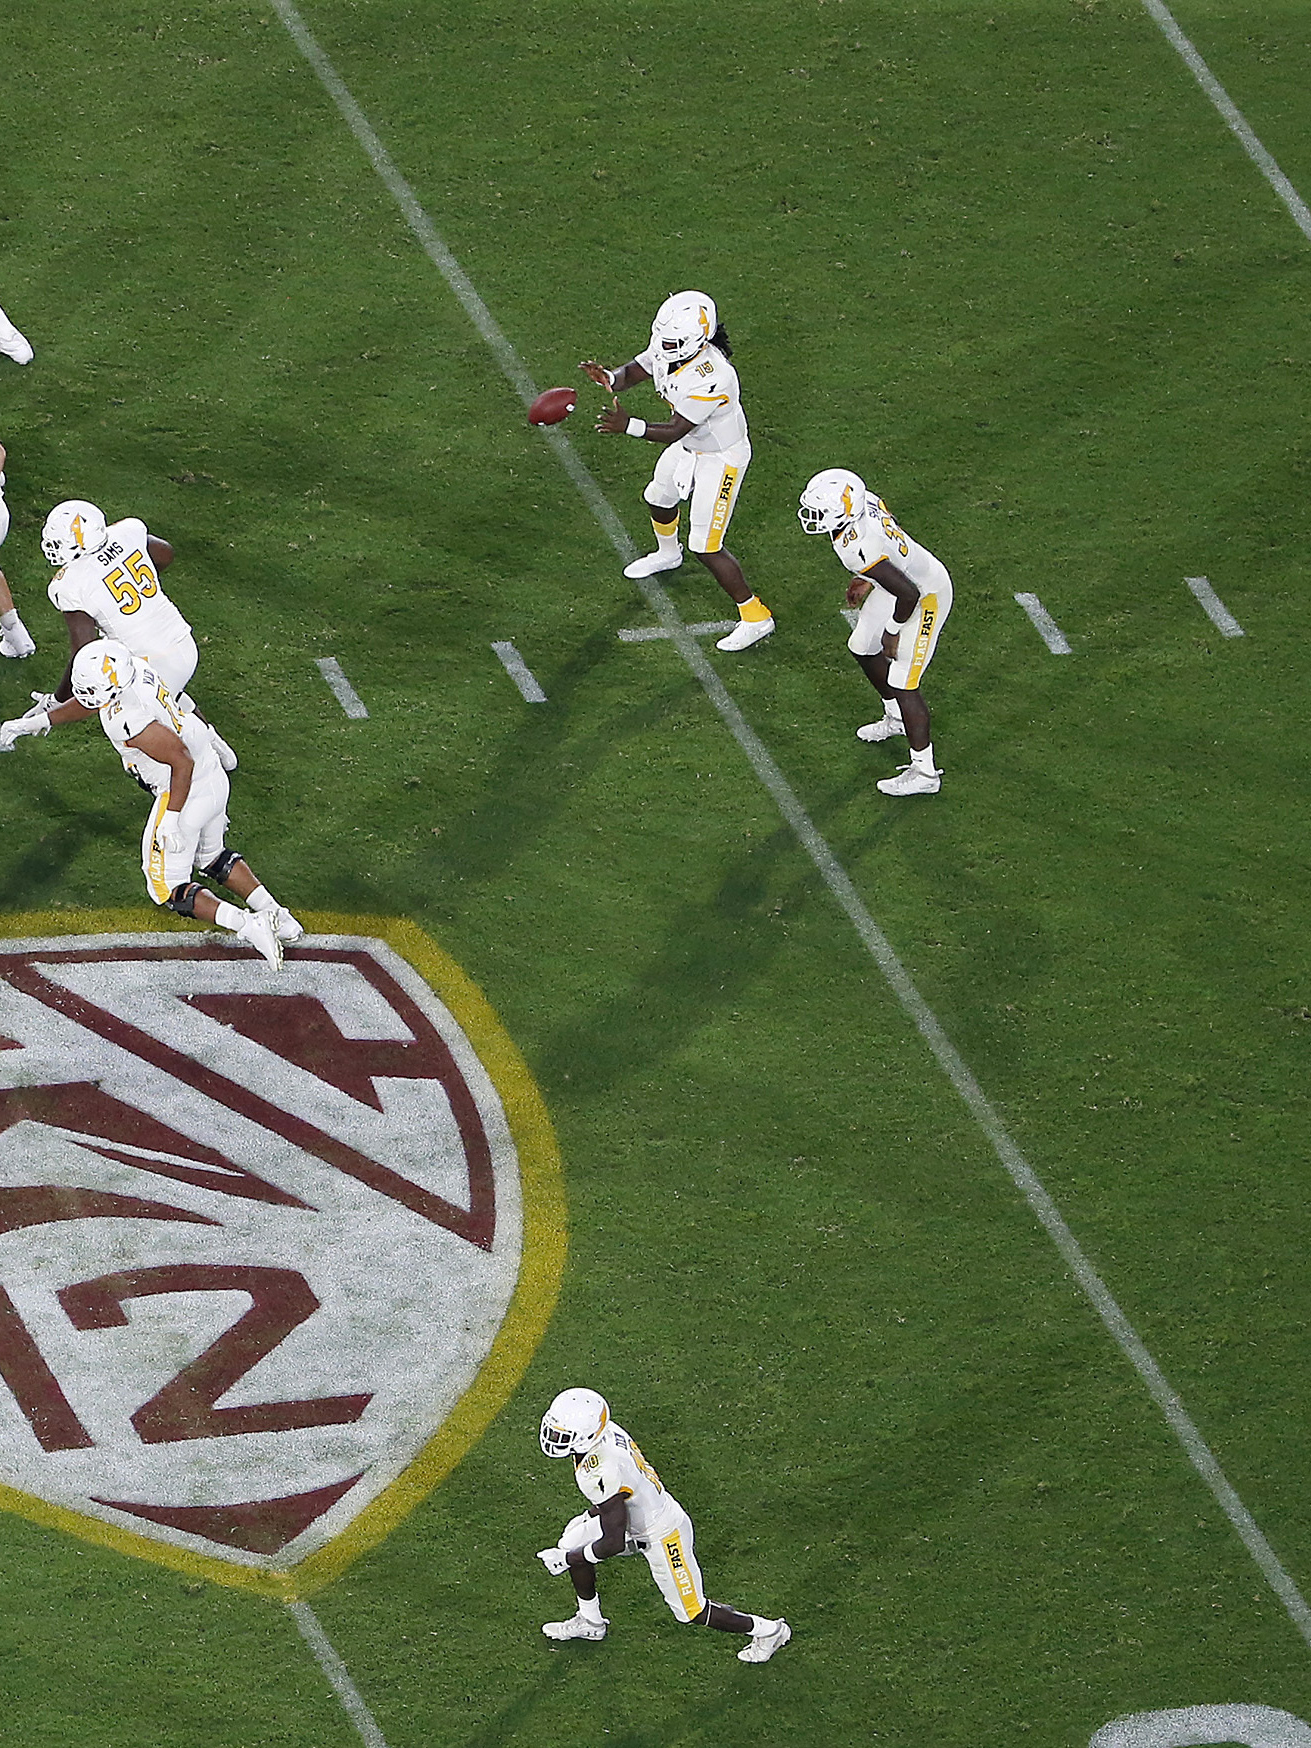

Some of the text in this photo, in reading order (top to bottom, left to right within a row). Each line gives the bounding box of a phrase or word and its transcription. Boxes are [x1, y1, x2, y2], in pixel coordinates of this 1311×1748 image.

[695, 361, 714, 378] 15
[97, 541, 124, 567] SAMS
[102, 549, 158, 615] 55
[583, 1454, 599, 1474] 10
